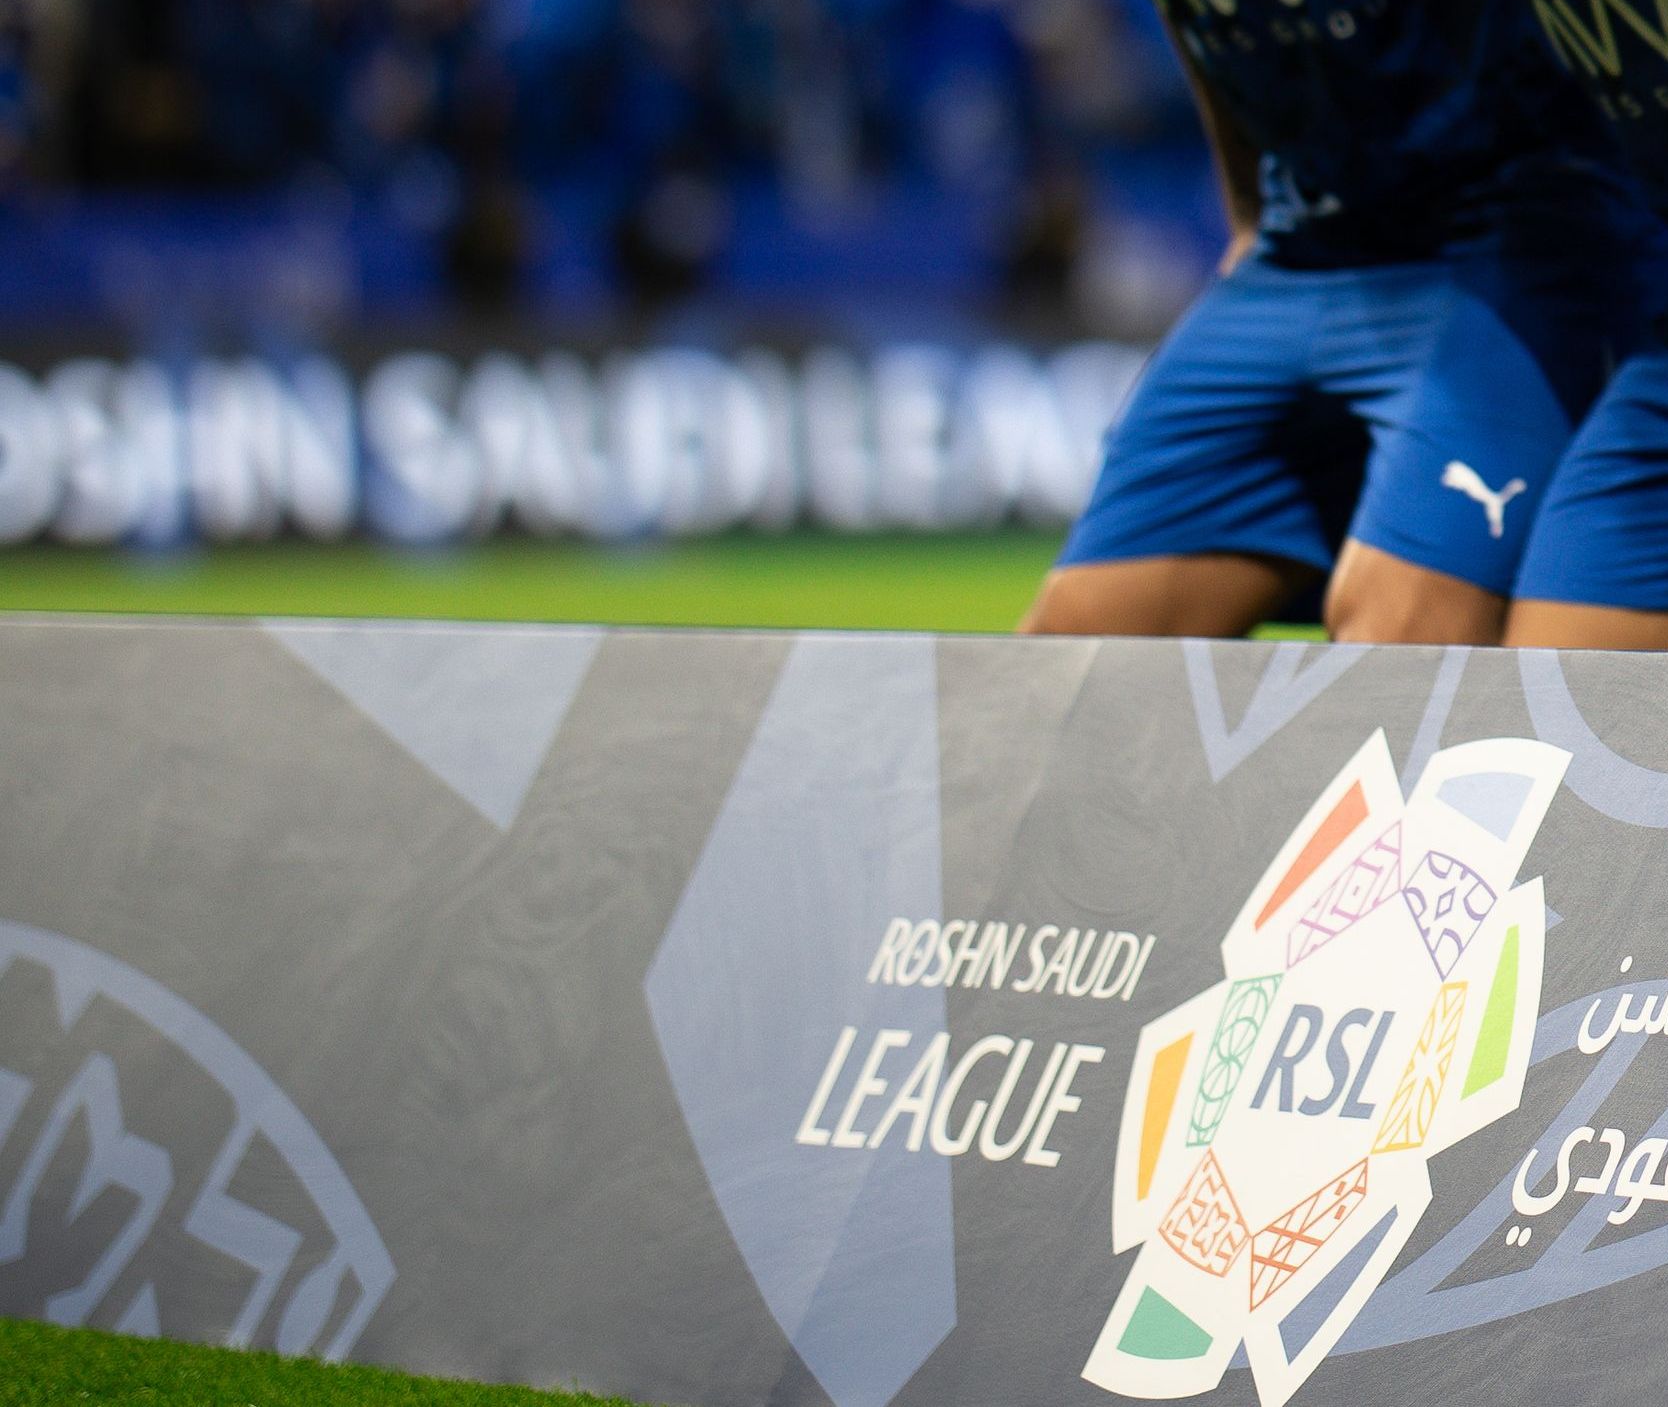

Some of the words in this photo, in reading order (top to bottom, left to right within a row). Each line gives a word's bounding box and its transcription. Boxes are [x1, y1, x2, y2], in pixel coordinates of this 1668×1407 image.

[867, 917, 1027, 990] ROSHN
[1012, 924, 1157, 1002] SAUDI
[795, 1026, 1106, 1168] LEAGUE
[1250, 1003, 1395, 1120] RSL
